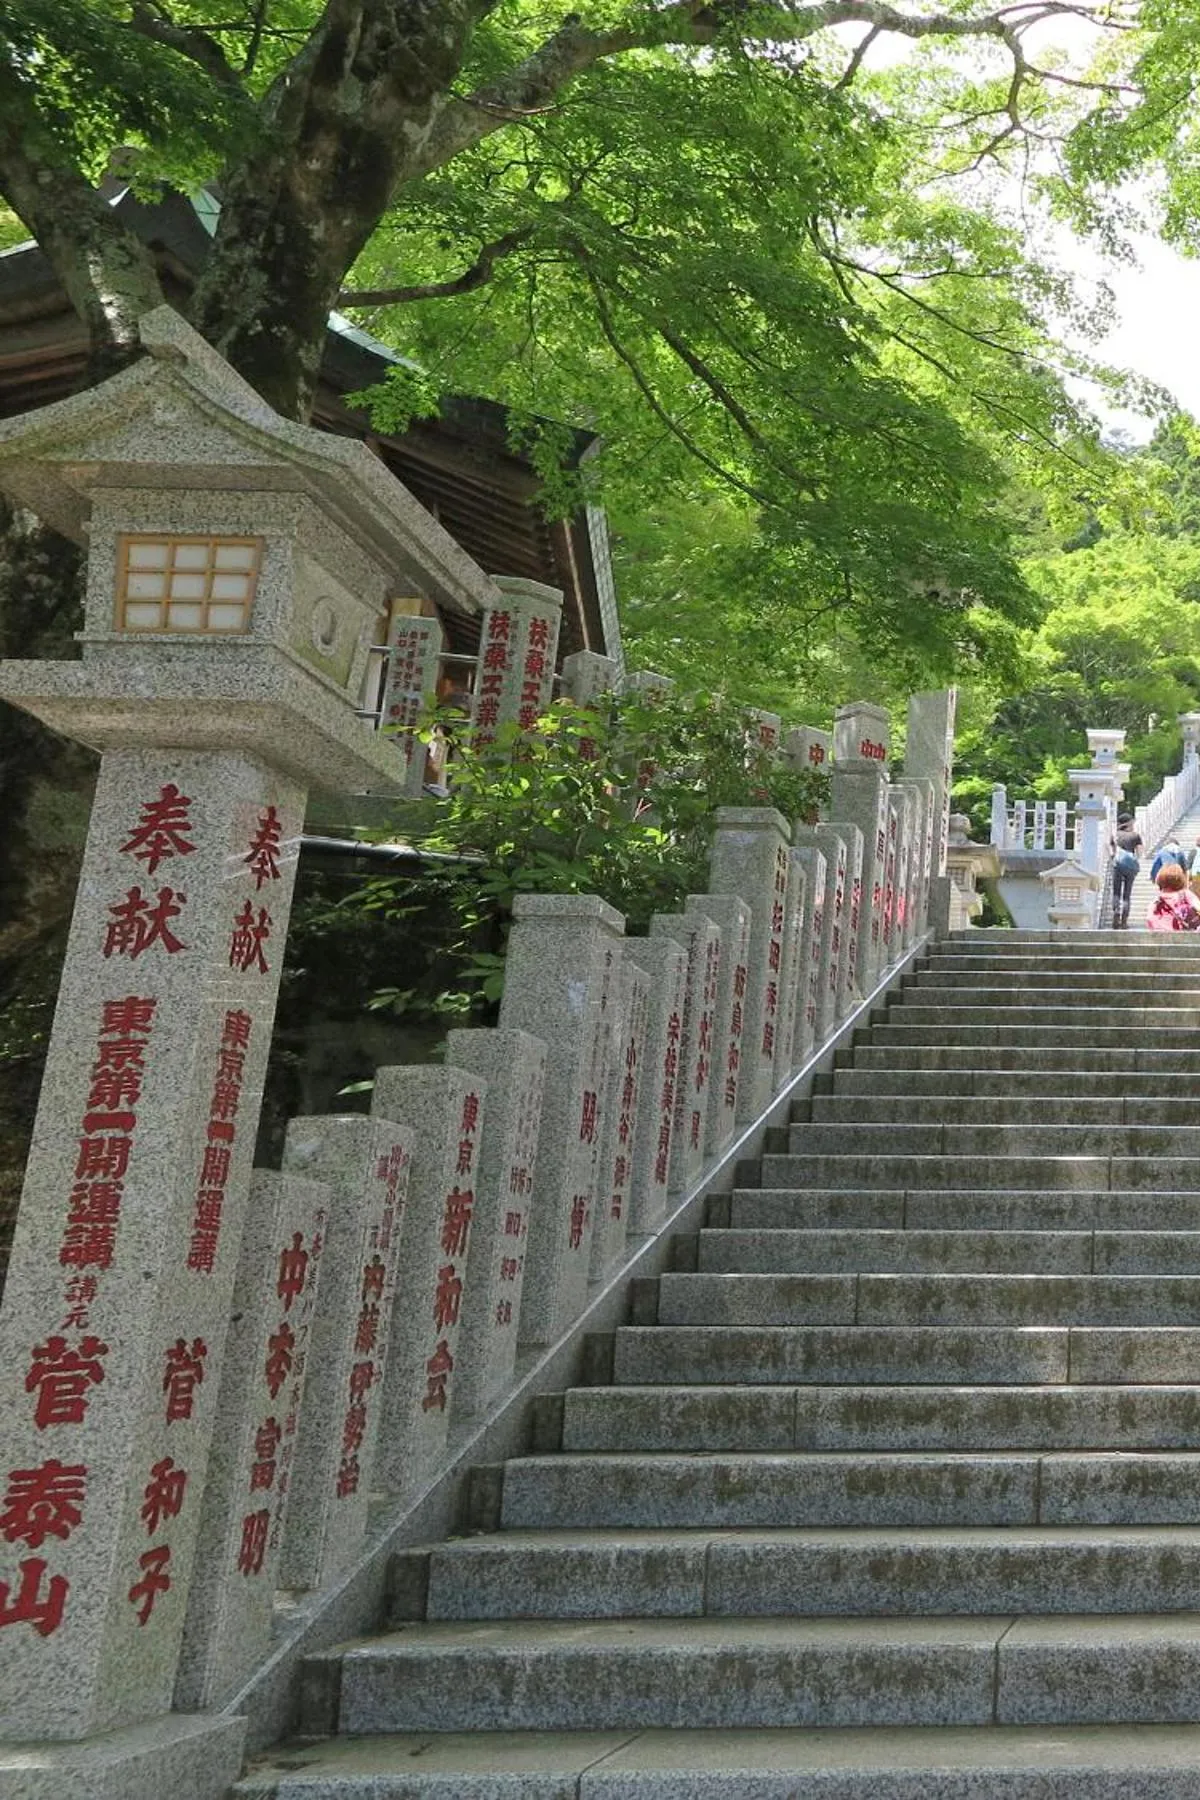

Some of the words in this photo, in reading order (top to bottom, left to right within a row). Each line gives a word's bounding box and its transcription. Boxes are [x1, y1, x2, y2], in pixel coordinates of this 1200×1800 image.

[104, 783, 197, 960] 奉献
[229, 806, 282, 974] 奉献
[58, 996, 156, 1270] 東京第一開運講
[187, 1009, 252, 1274] 東京第一開運講
[0, 1335, 109, 1637] 菅泰山
[128, 1337, 209, 1627] 菅和子
